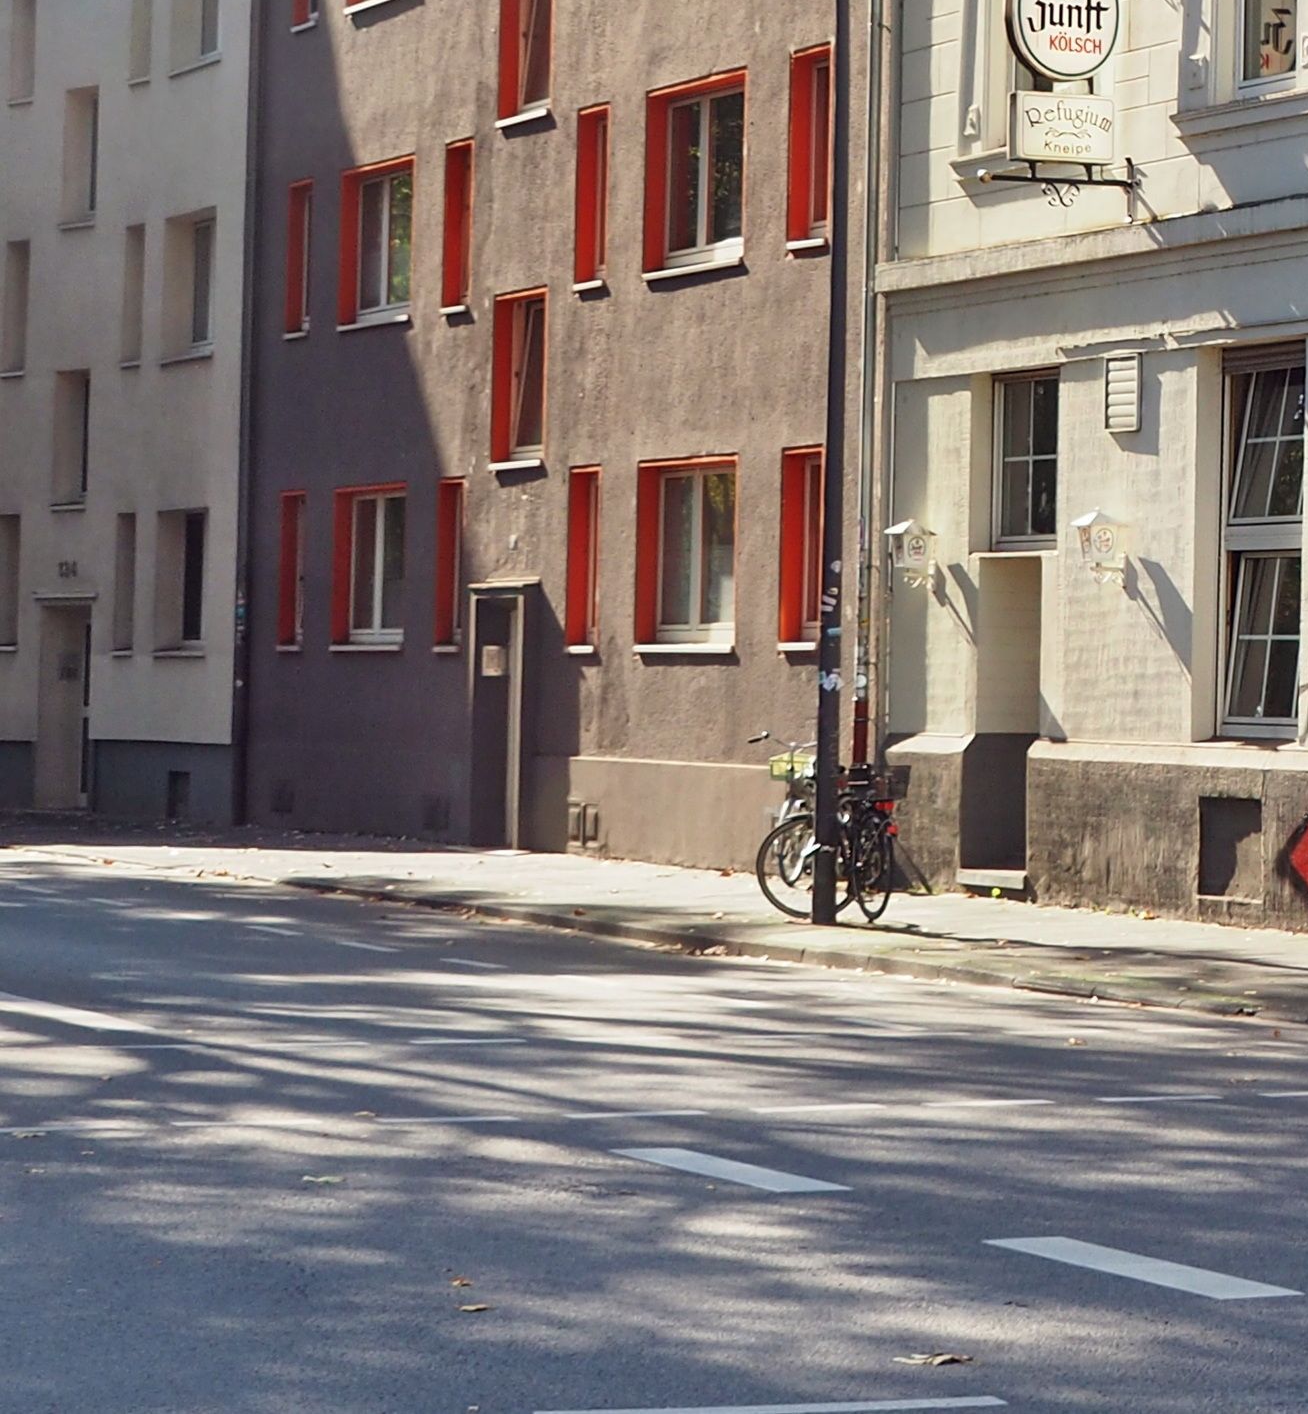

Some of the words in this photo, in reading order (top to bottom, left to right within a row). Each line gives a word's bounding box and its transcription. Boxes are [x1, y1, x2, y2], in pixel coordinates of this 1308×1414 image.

[1049, 32, 1102, 56] KÖLSCH
[1025, 99, 1112, 133] Refugium
[1043, 140, 1092, 155] Kneipe
